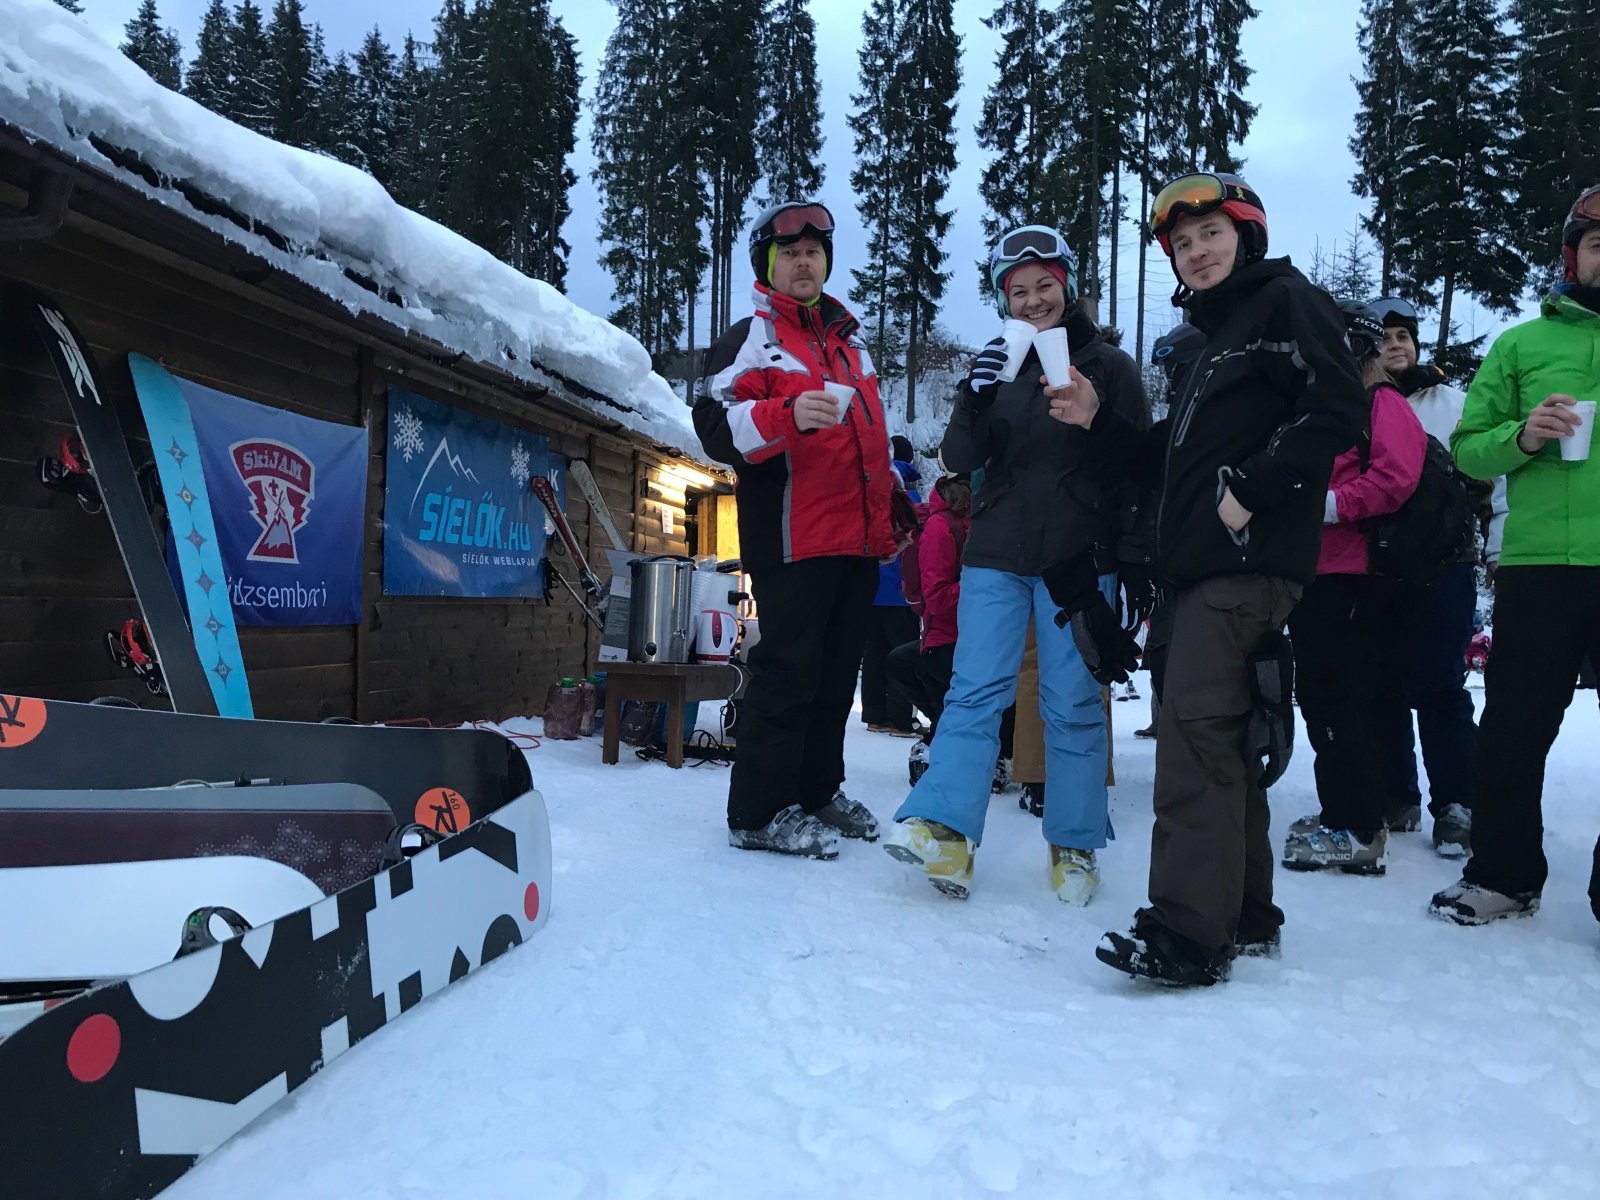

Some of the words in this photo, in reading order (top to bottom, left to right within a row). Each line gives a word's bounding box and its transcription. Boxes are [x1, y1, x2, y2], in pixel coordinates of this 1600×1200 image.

[243, 449, 303, 481] SkiJAM
[418, 484, 531, 551] SÍELŐK.HU
[493, 556, 536, 566] WEBLAPJA
[447, 791, 461, 810] 160
